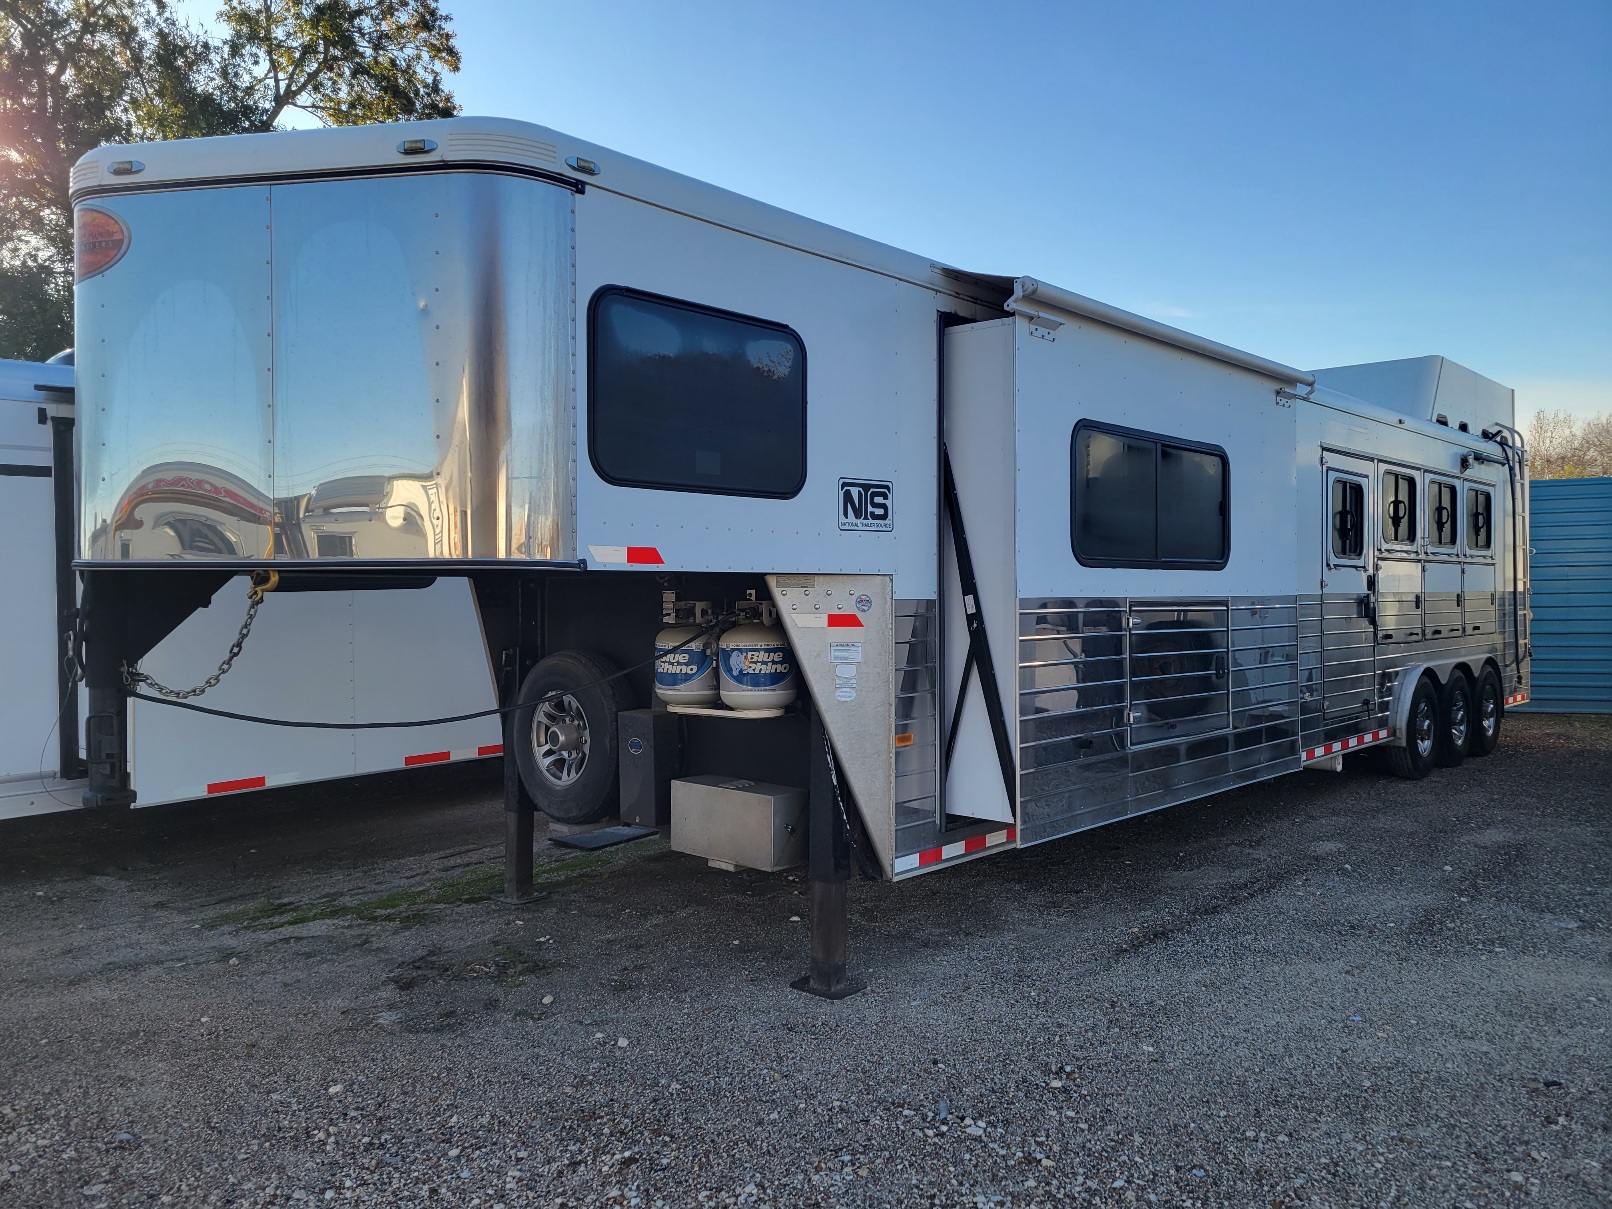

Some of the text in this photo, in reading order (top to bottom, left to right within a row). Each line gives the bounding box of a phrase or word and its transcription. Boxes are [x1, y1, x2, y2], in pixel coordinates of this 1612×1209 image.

[841, 482, 891, 520] NTS
[748, 651, 783, 662] Blue
[658, 662, 698, 674] Rhino
[743, 662, 790, 673] Rhino
